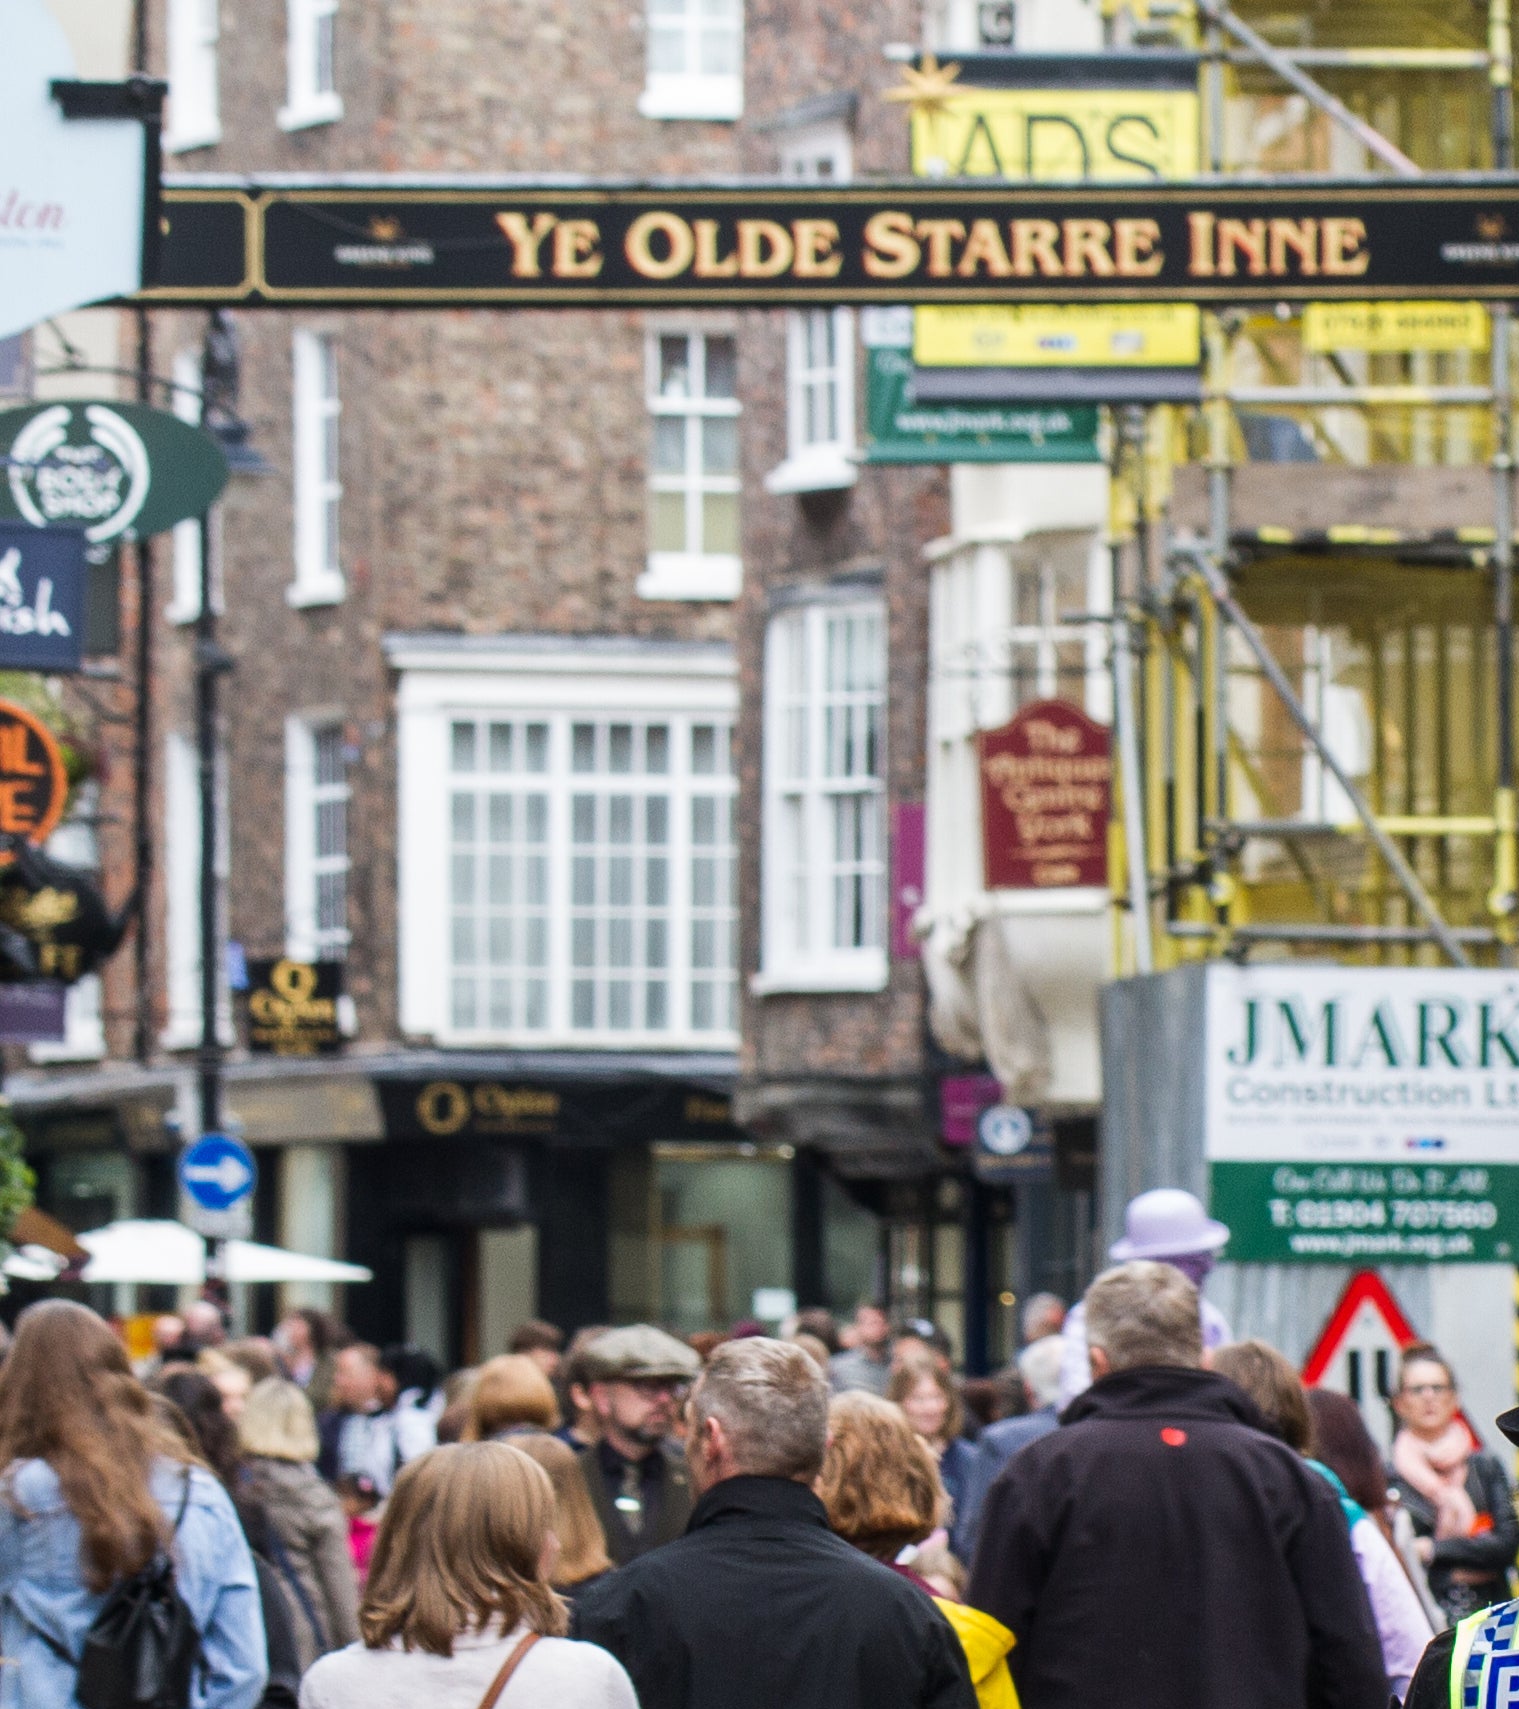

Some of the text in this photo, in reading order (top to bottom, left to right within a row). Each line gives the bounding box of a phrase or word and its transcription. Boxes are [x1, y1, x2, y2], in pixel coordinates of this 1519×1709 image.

[495, 211, 1371, 279] YE OLDE STARRE INNE
[1226, 1075, 1472, 1109] Construction
